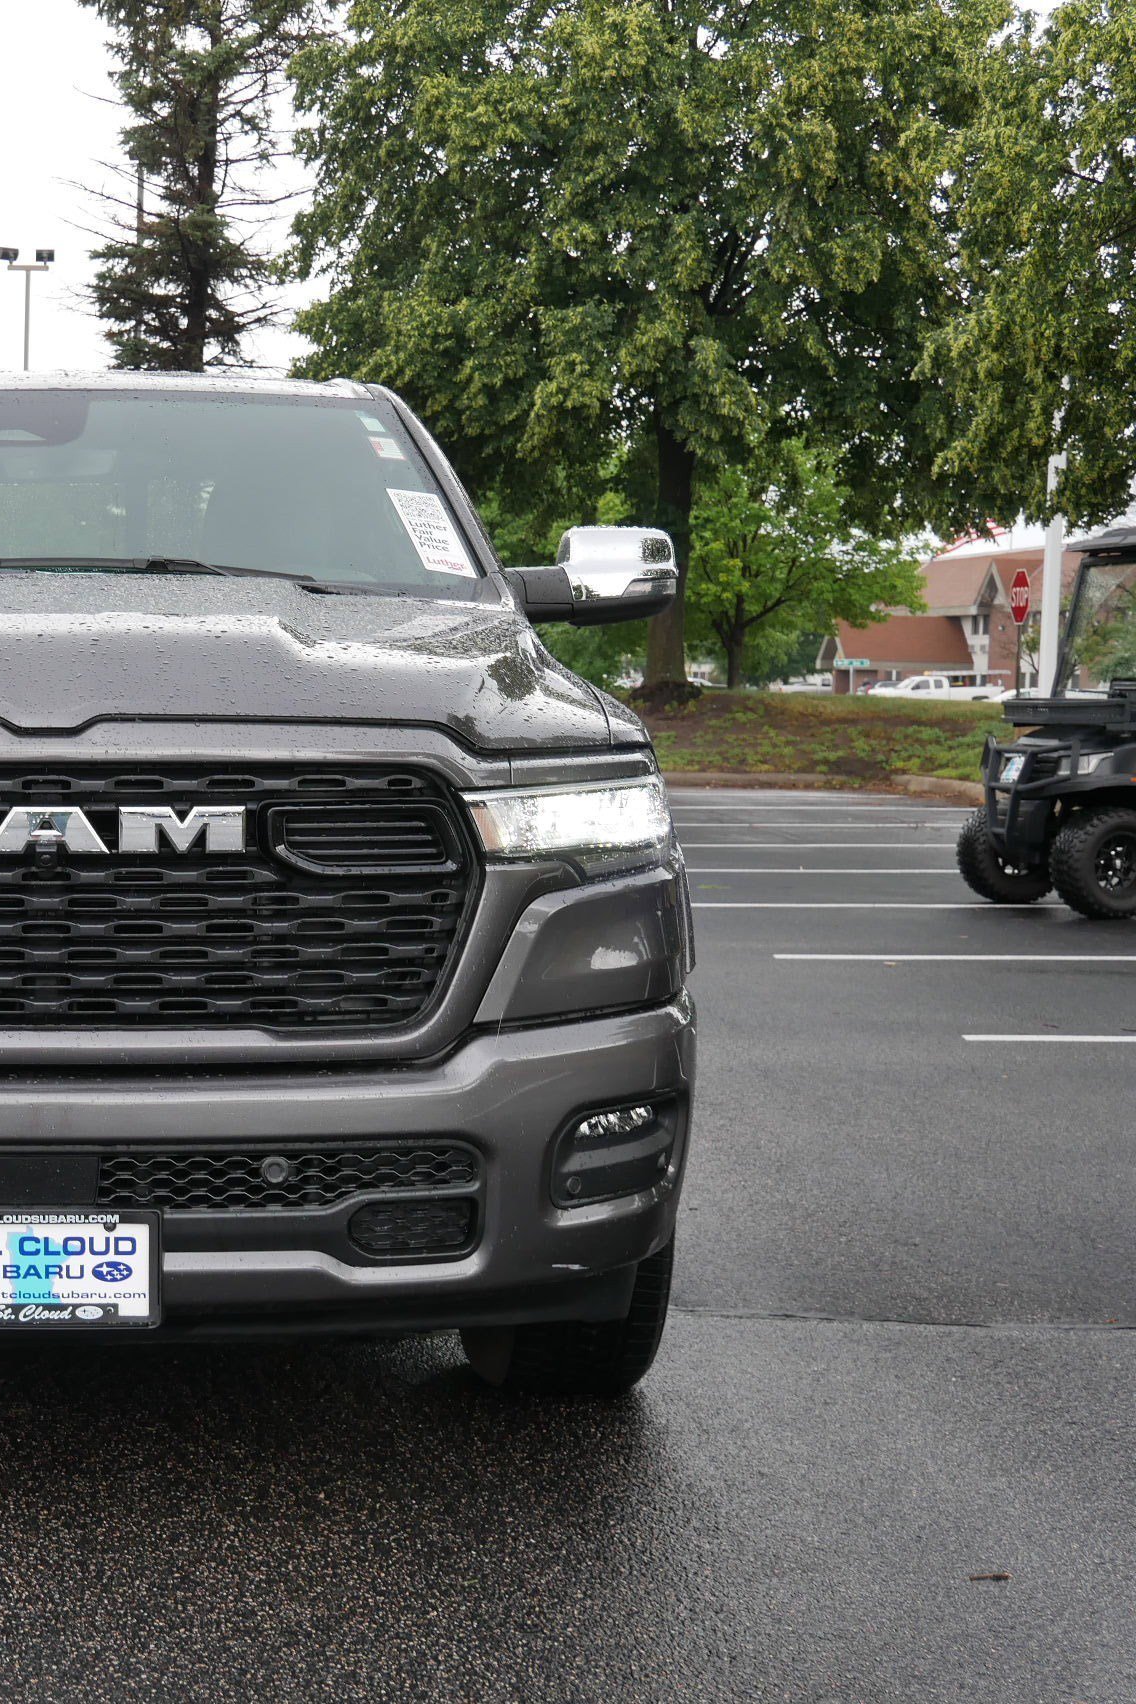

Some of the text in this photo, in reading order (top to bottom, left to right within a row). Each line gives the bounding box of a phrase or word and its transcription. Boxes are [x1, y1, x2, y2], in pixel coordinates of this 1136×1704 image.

[408, 520, 447, 532] Luther
[412, 527, 434, 536] Fair
[415, 534, 450, 546] Value
[419, 541, 450, 552] Price
[426, 556, 467, 570] Luther
[1011, 587, 1028, 607] STOP
[18, 1236, 137, 1256] CLOUD
[18, 1304, 73, 1321] Cloud
